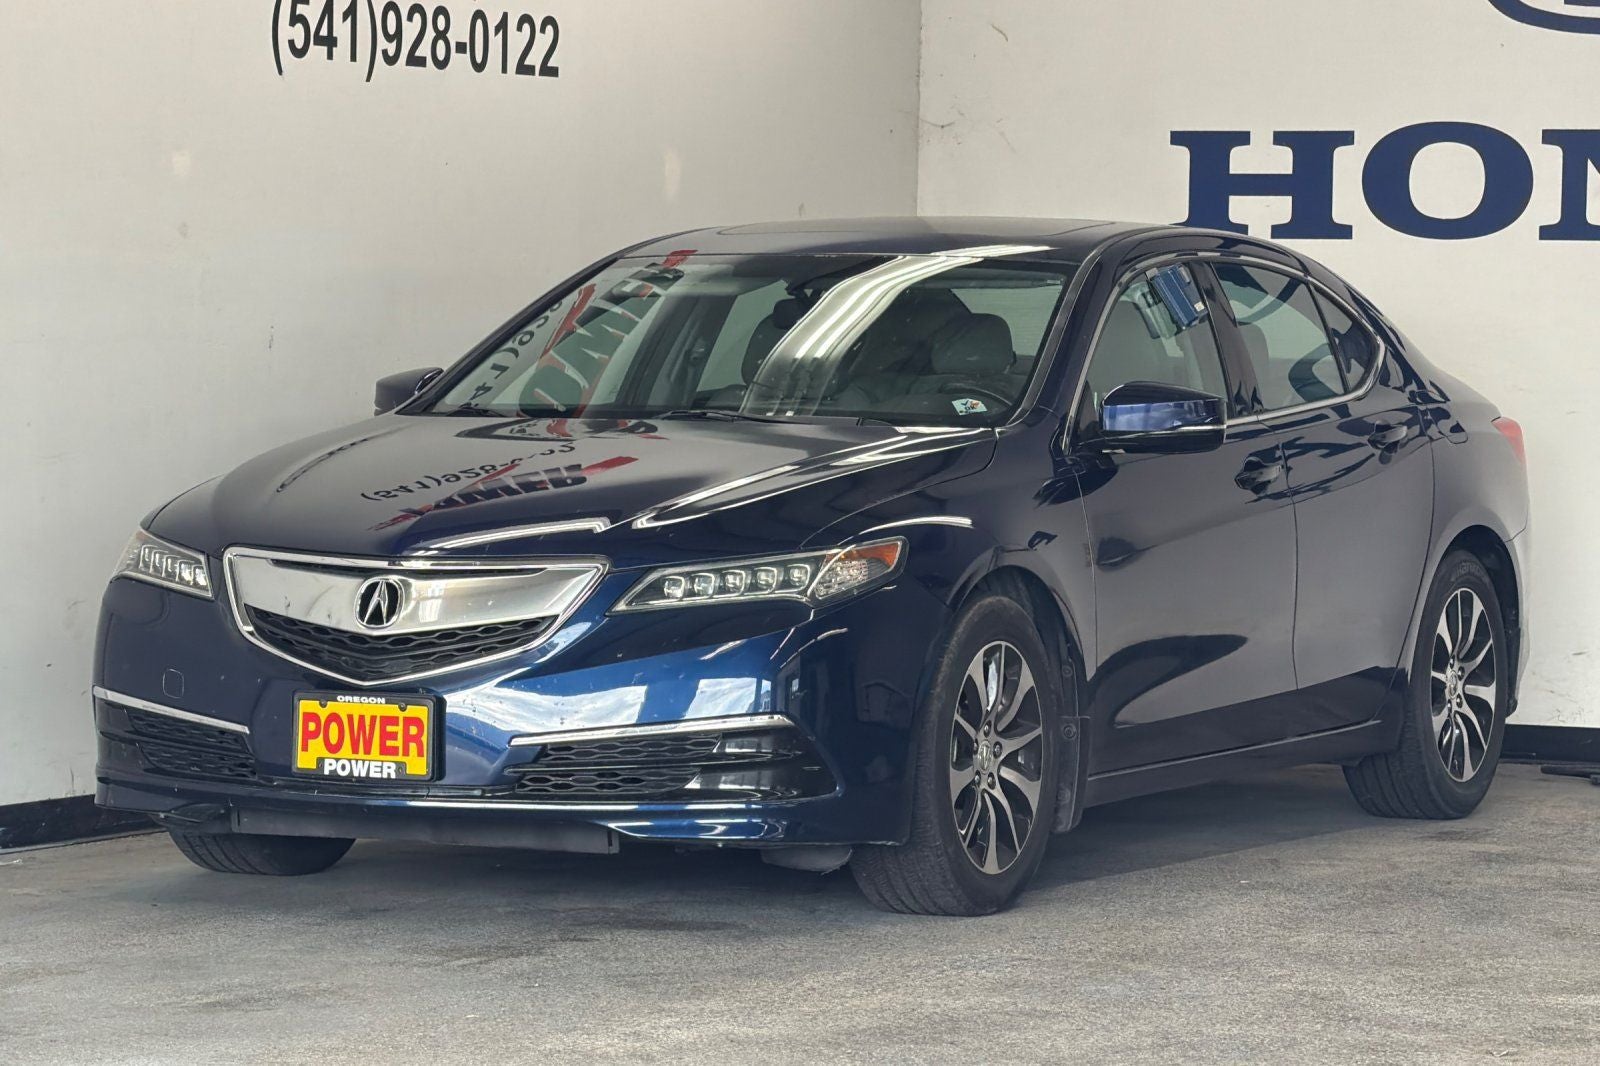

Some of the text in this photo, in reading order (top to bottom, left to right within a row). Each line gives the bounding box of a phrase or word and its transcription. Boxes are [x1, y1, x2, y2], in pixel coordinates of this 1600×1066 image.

[272, 0, 559, 82] (541)928-0122
[336, 695, 386, 704] OREGON
[301, 711, 425, 757] POWER
[323, 758, 396, 779] POWER
